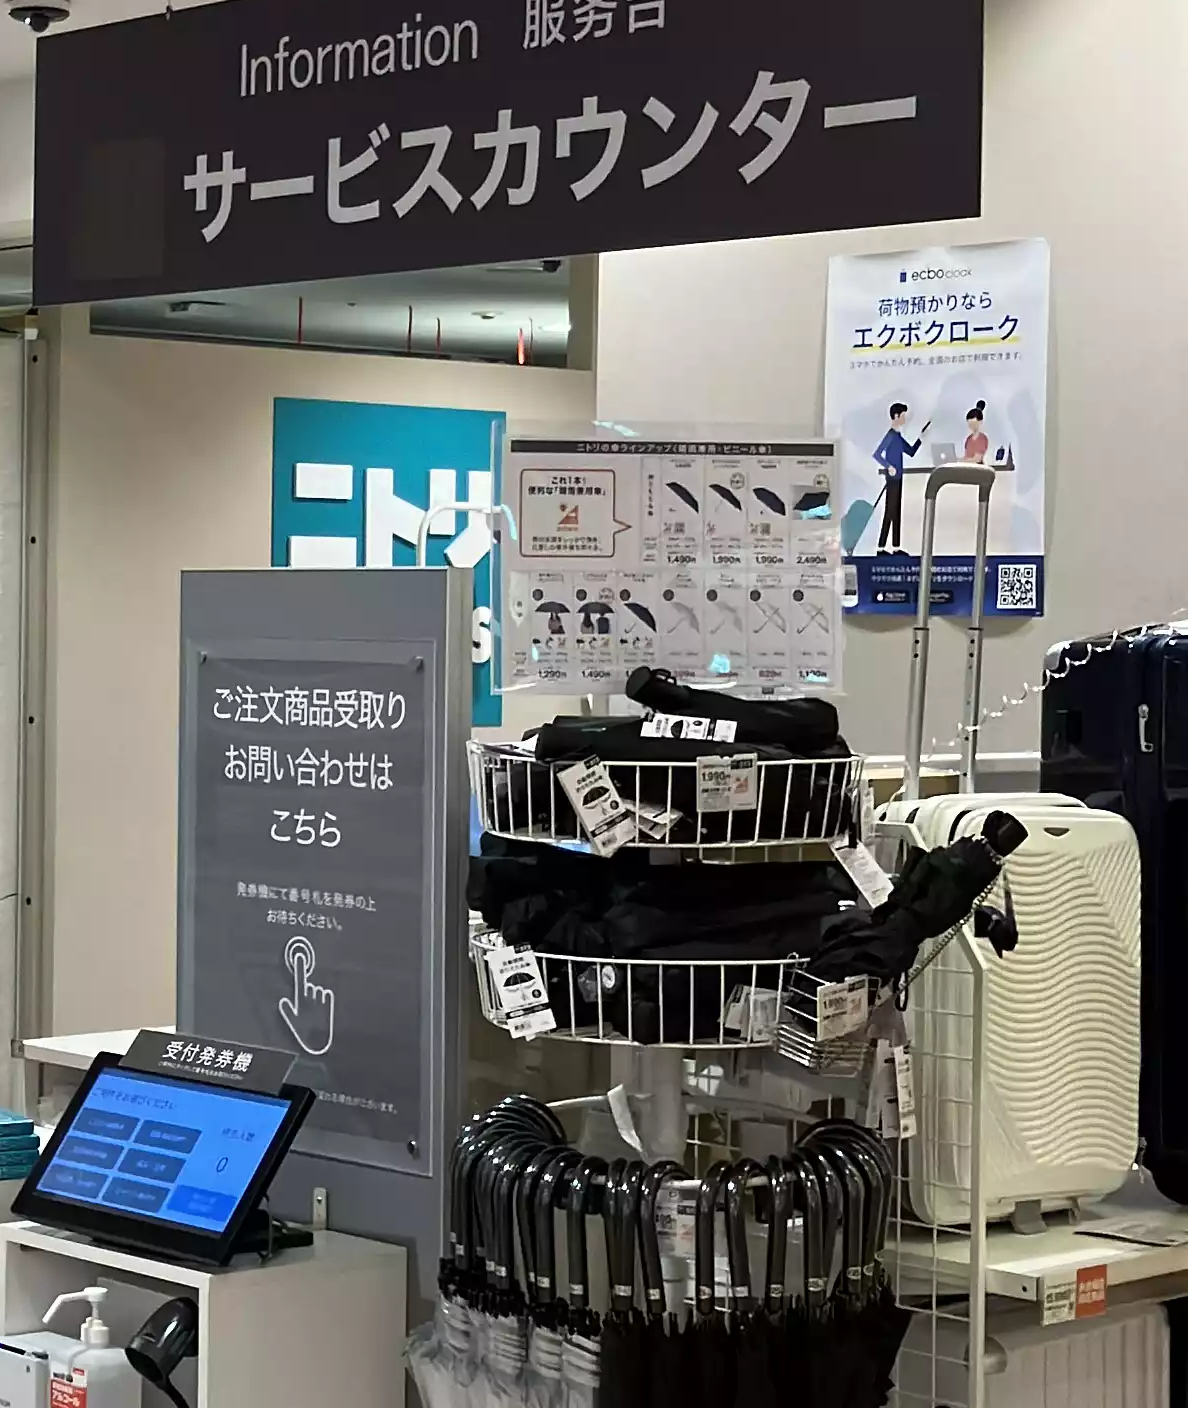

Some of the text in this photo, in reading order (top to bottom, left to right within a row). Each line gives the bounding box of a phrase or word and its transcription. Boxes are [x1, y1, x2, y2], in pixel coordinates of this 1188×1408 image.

[239, 13, 479, 98] Information
[182, 68, 918, 244] サービスカウンター
[878, 291, 993, 317] 荷物預かりなら
[853, 314, 1019, 349] エクボクローク
[212, 685, 407, 731] ご注文商品受取り
[223, 744, 394, 791] お問い合わせは
[268, 808, 343, 849] こちら
[162, 1041, 253, 1073] 受付発券機
